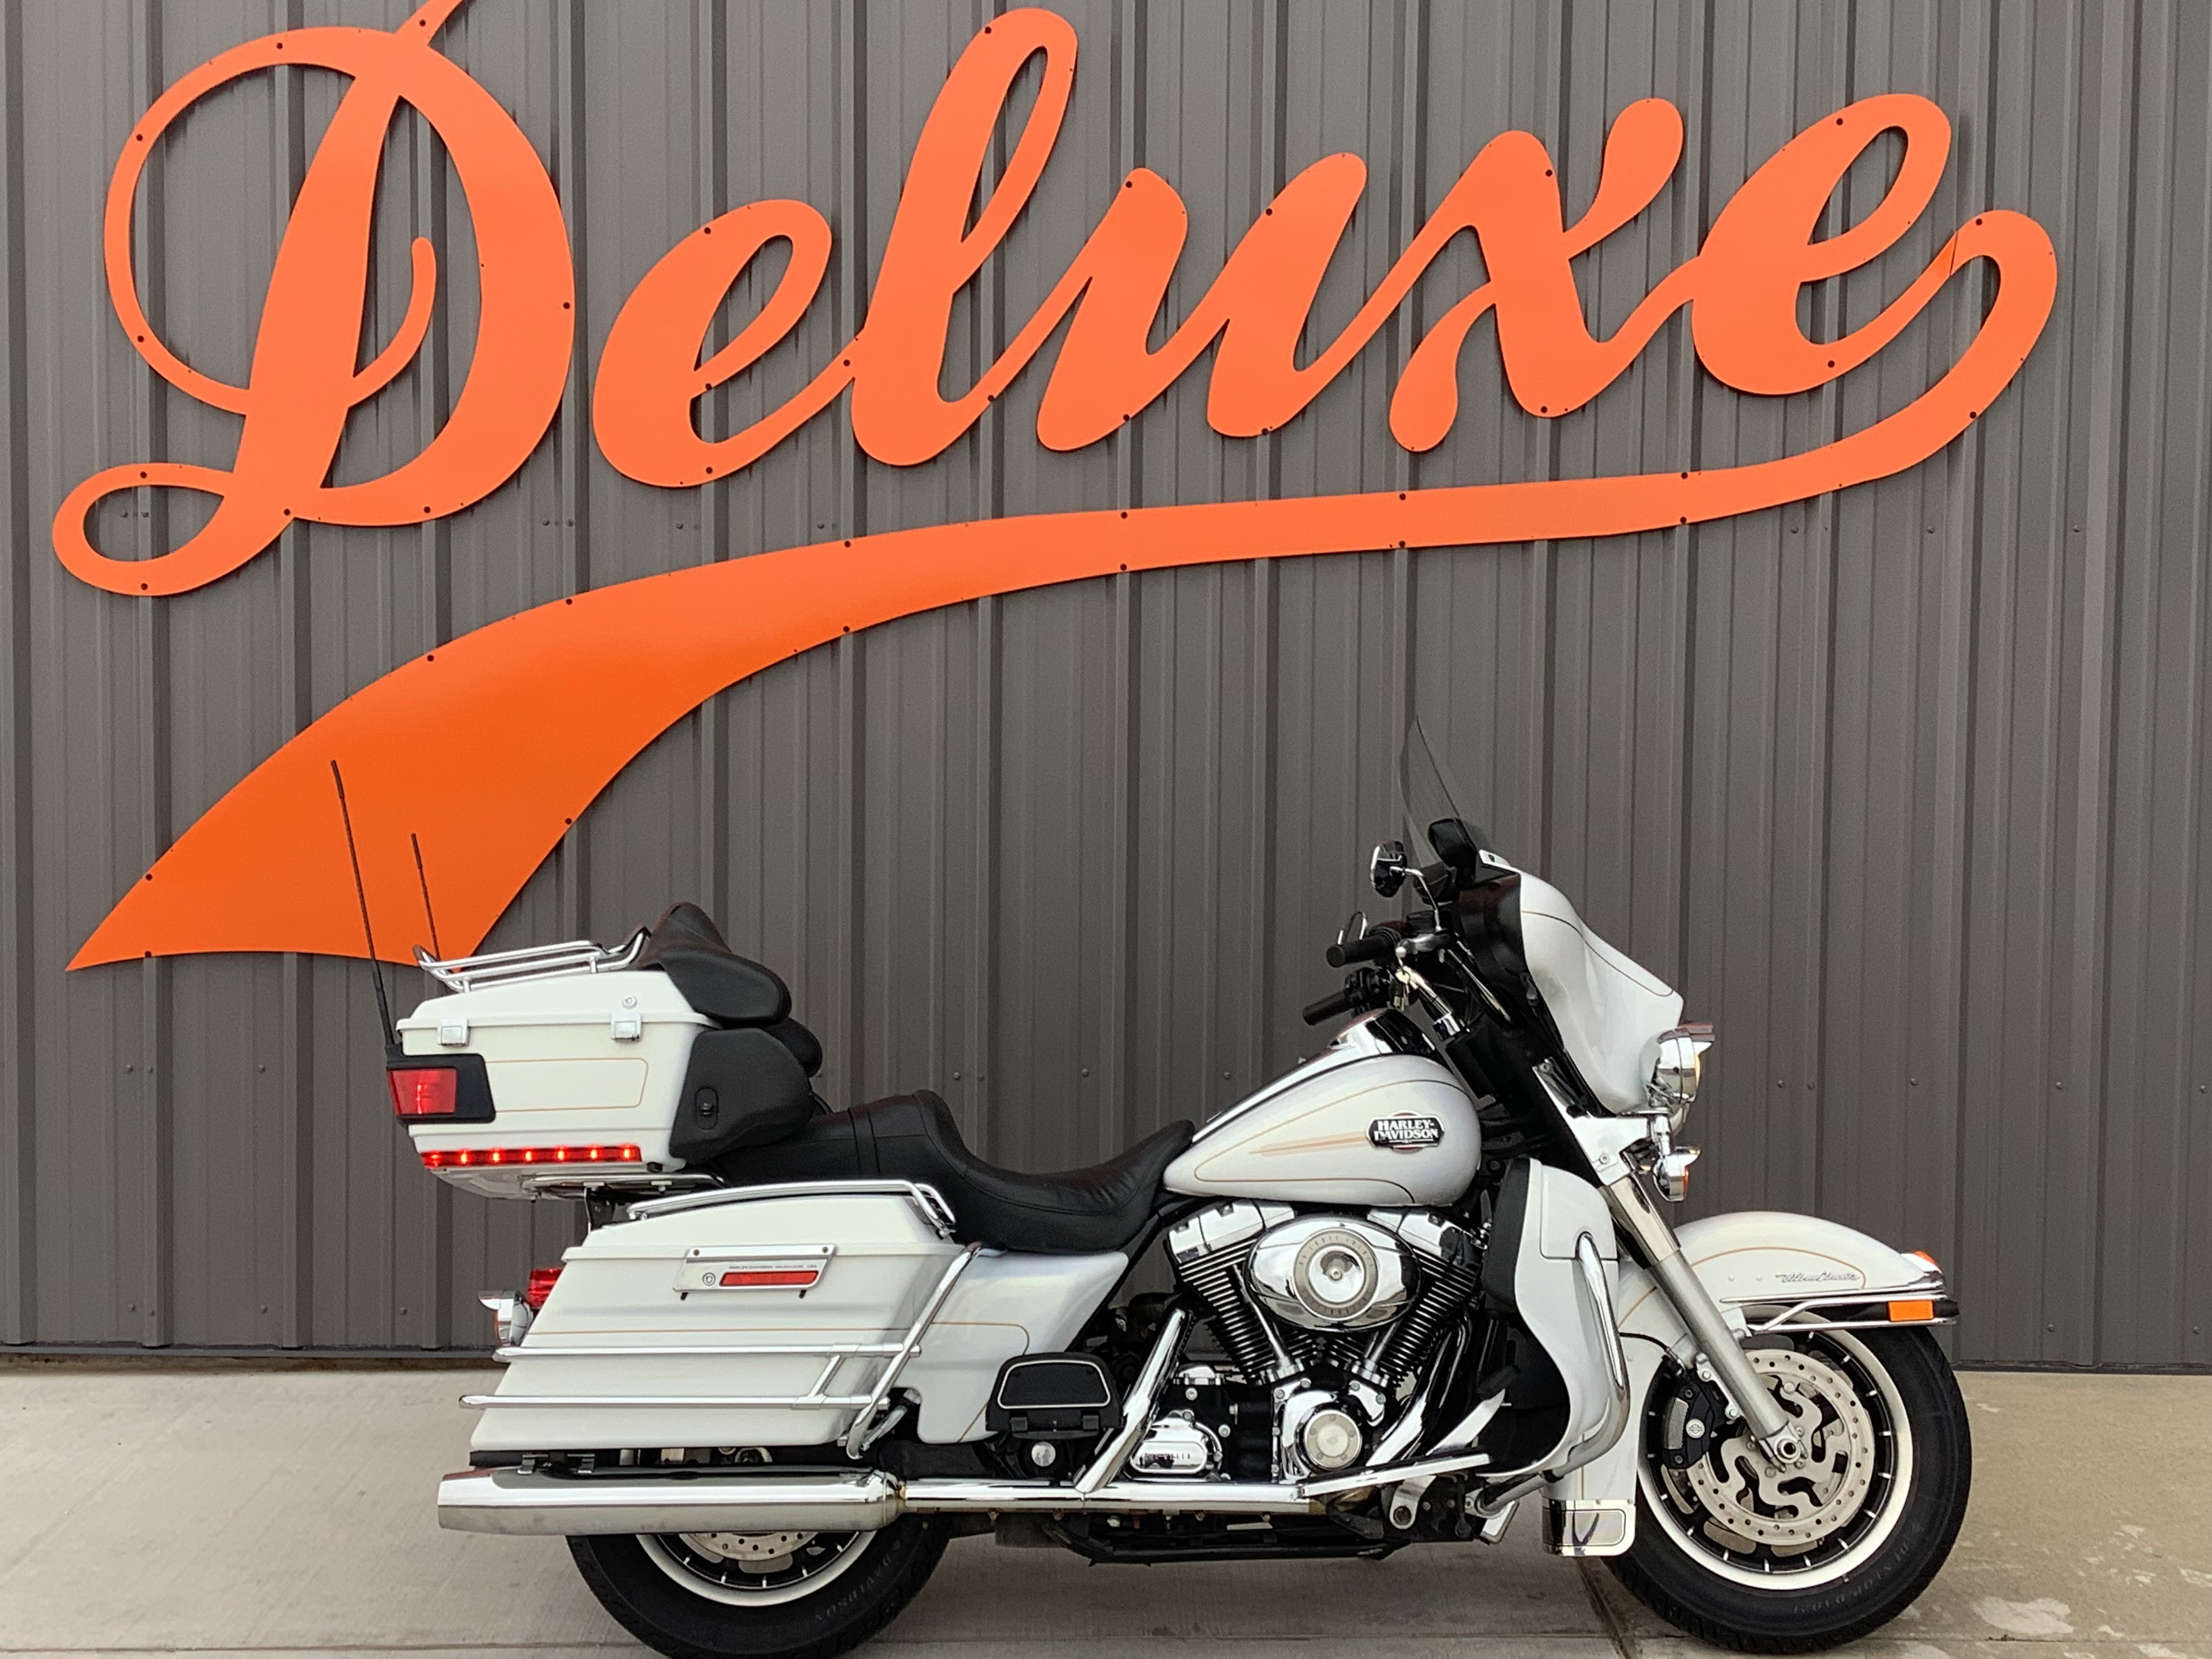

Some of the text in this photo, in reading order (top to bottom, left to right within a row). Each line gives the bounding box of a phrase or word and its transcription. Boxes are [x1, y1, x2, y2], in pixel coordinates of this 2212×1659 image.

[53, 0, 2057, 598] Deluxe
[1377, 1120, 1435, 1131] HARLEY-
[1374, 1129, 1438, 1141] DAVIDSON
